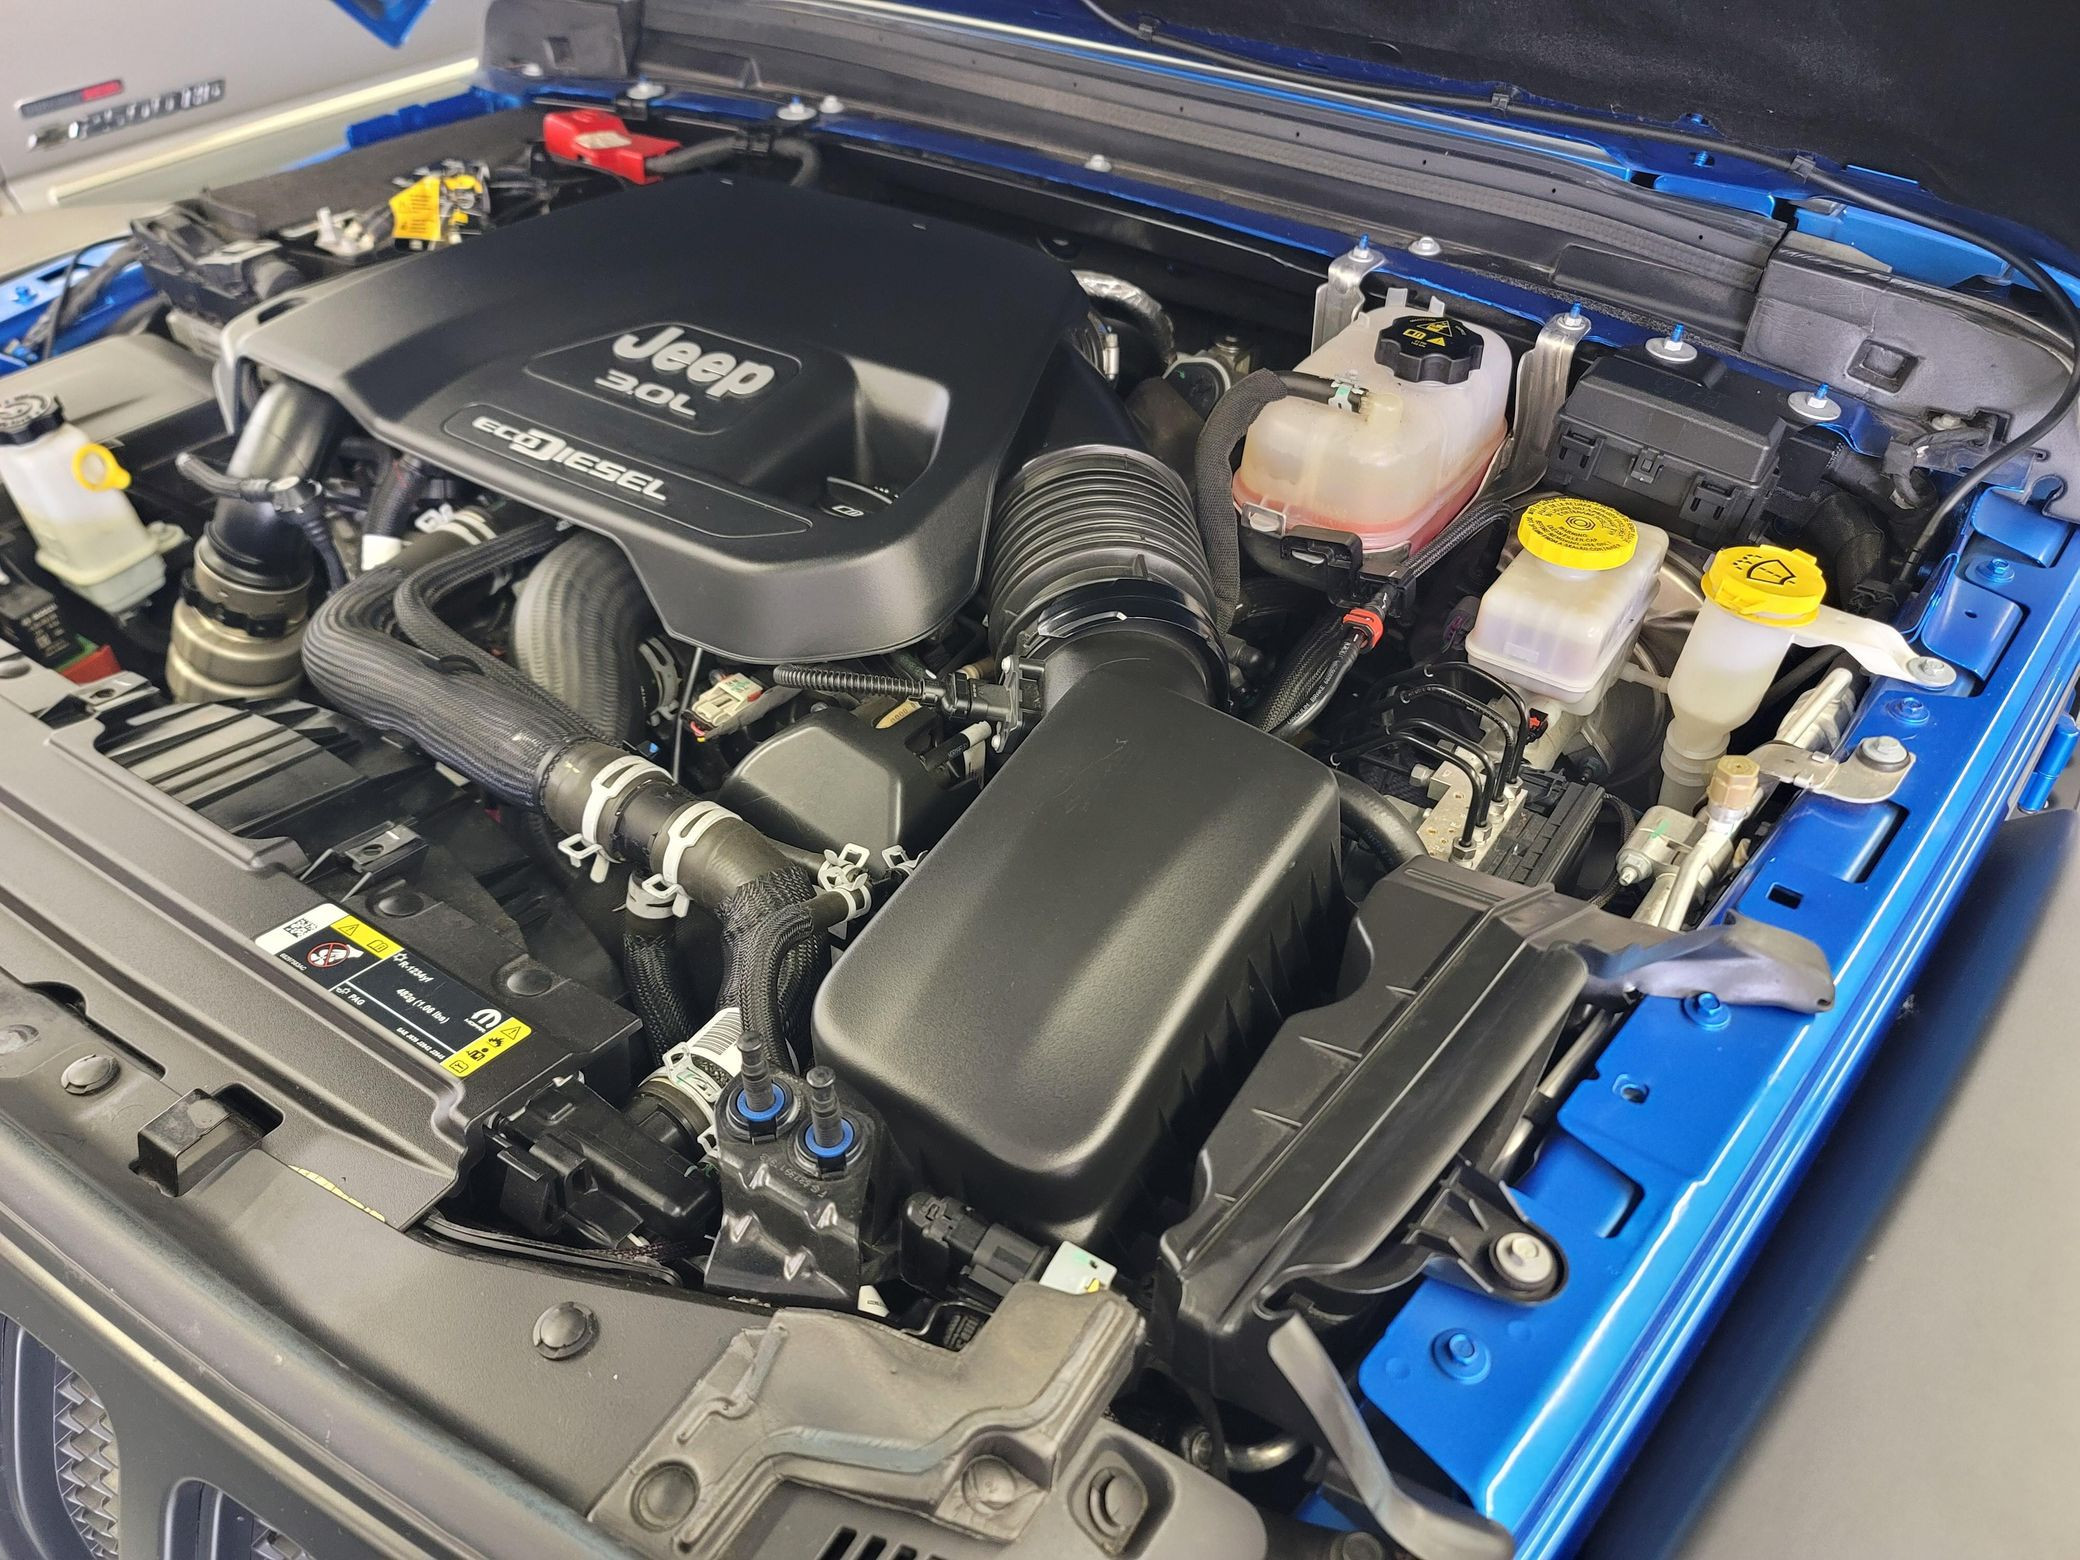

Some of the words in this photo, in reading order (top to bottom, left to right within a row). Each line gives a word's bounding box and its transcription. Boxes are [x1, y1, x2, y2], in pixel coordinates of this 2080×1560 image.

[612, 327, 775, 398] Jeep
[595, 369, 696, 417] 3.0L
[1310, 685, 1326, 703] BRAKE
[399, 961, 435, 983] R-1234yf
[348, 993, 366, 1006] PAG
[396, 988, 416, 1005] 482g
[431, 1008, 450, 1025] lbs)
